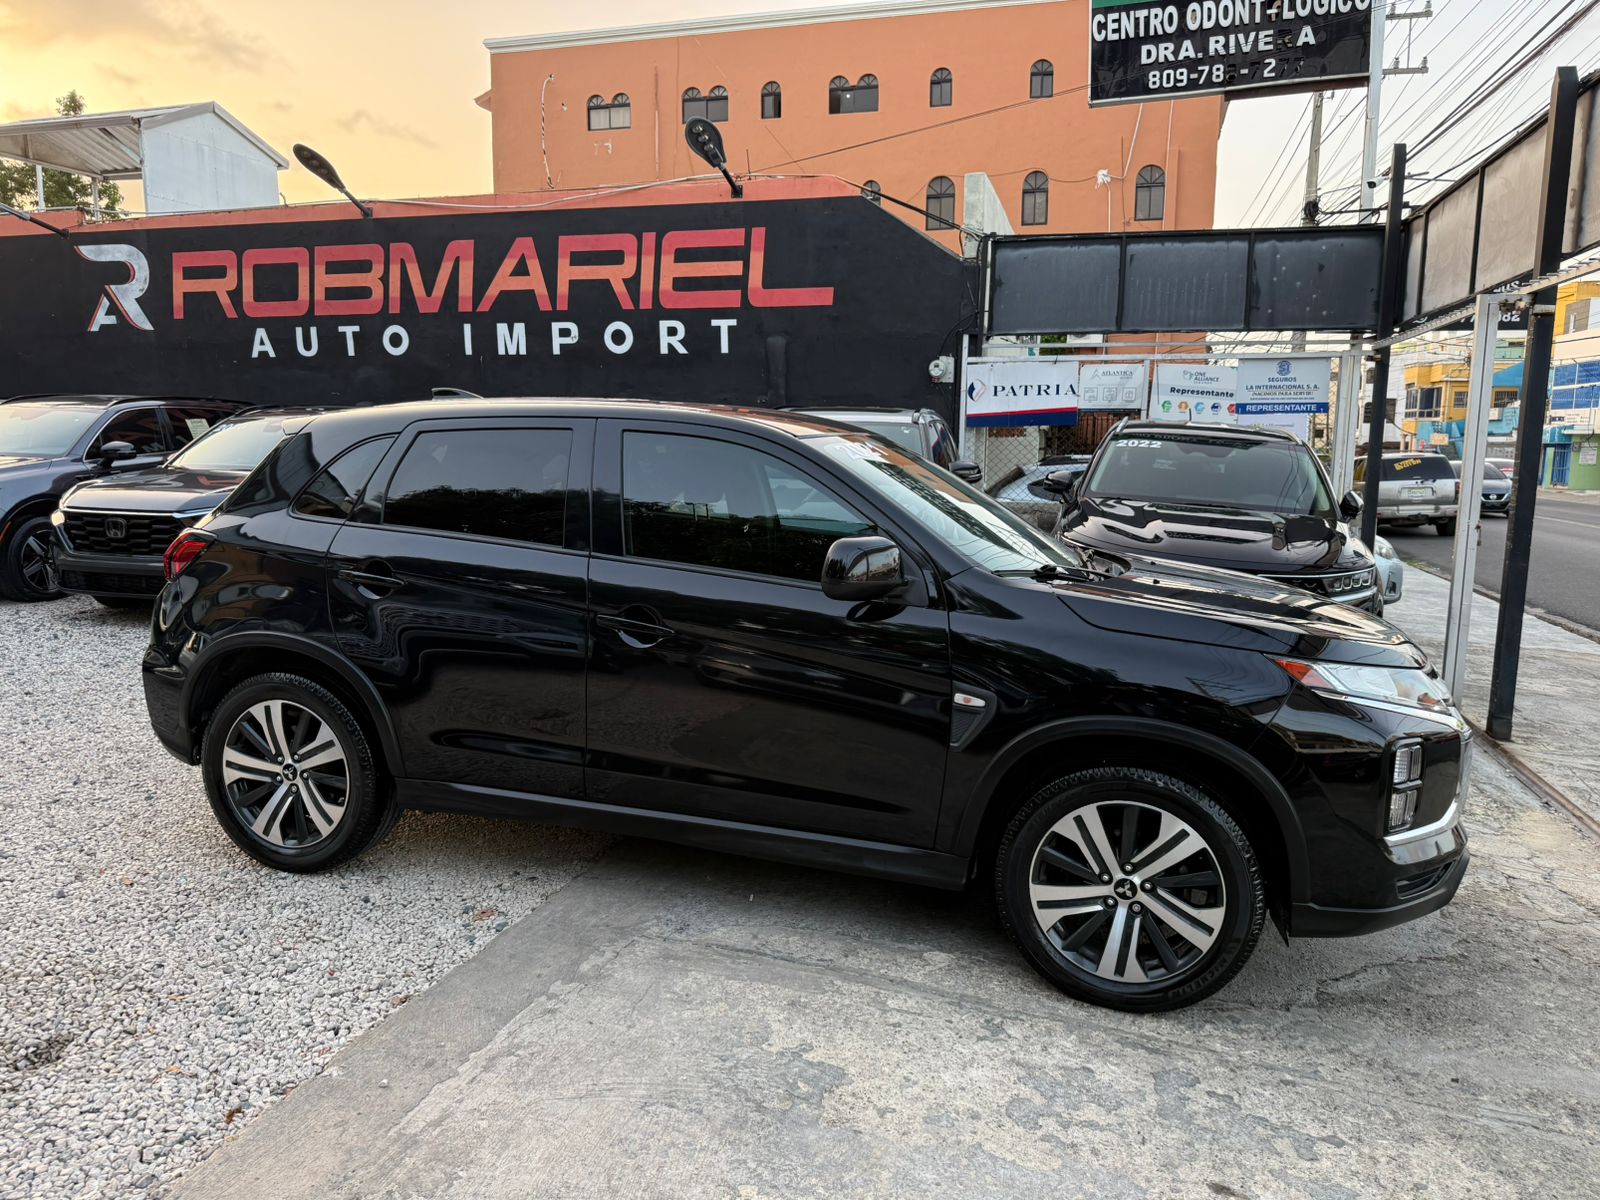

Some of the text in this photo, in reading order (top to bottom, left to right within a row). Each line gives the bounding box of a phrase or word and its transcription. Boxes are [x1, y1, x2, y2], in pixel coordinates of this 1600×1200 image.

[1092, 0, 1370, 42] CENTRO ODONTLOGIC
[1141, 43, 1203, 65] DRA.
[172, 227, 834, 320] ROBMARIEL
[251, 318, 737, 358] AUTO IMPORT
[993, 383, 1077, 397] PATRIA
[1170, 386, 1234, 398] Representante
[1245, 404, 1317, 412] REPRESENTANTE
[1116, 438, 1162, 448] 2022
